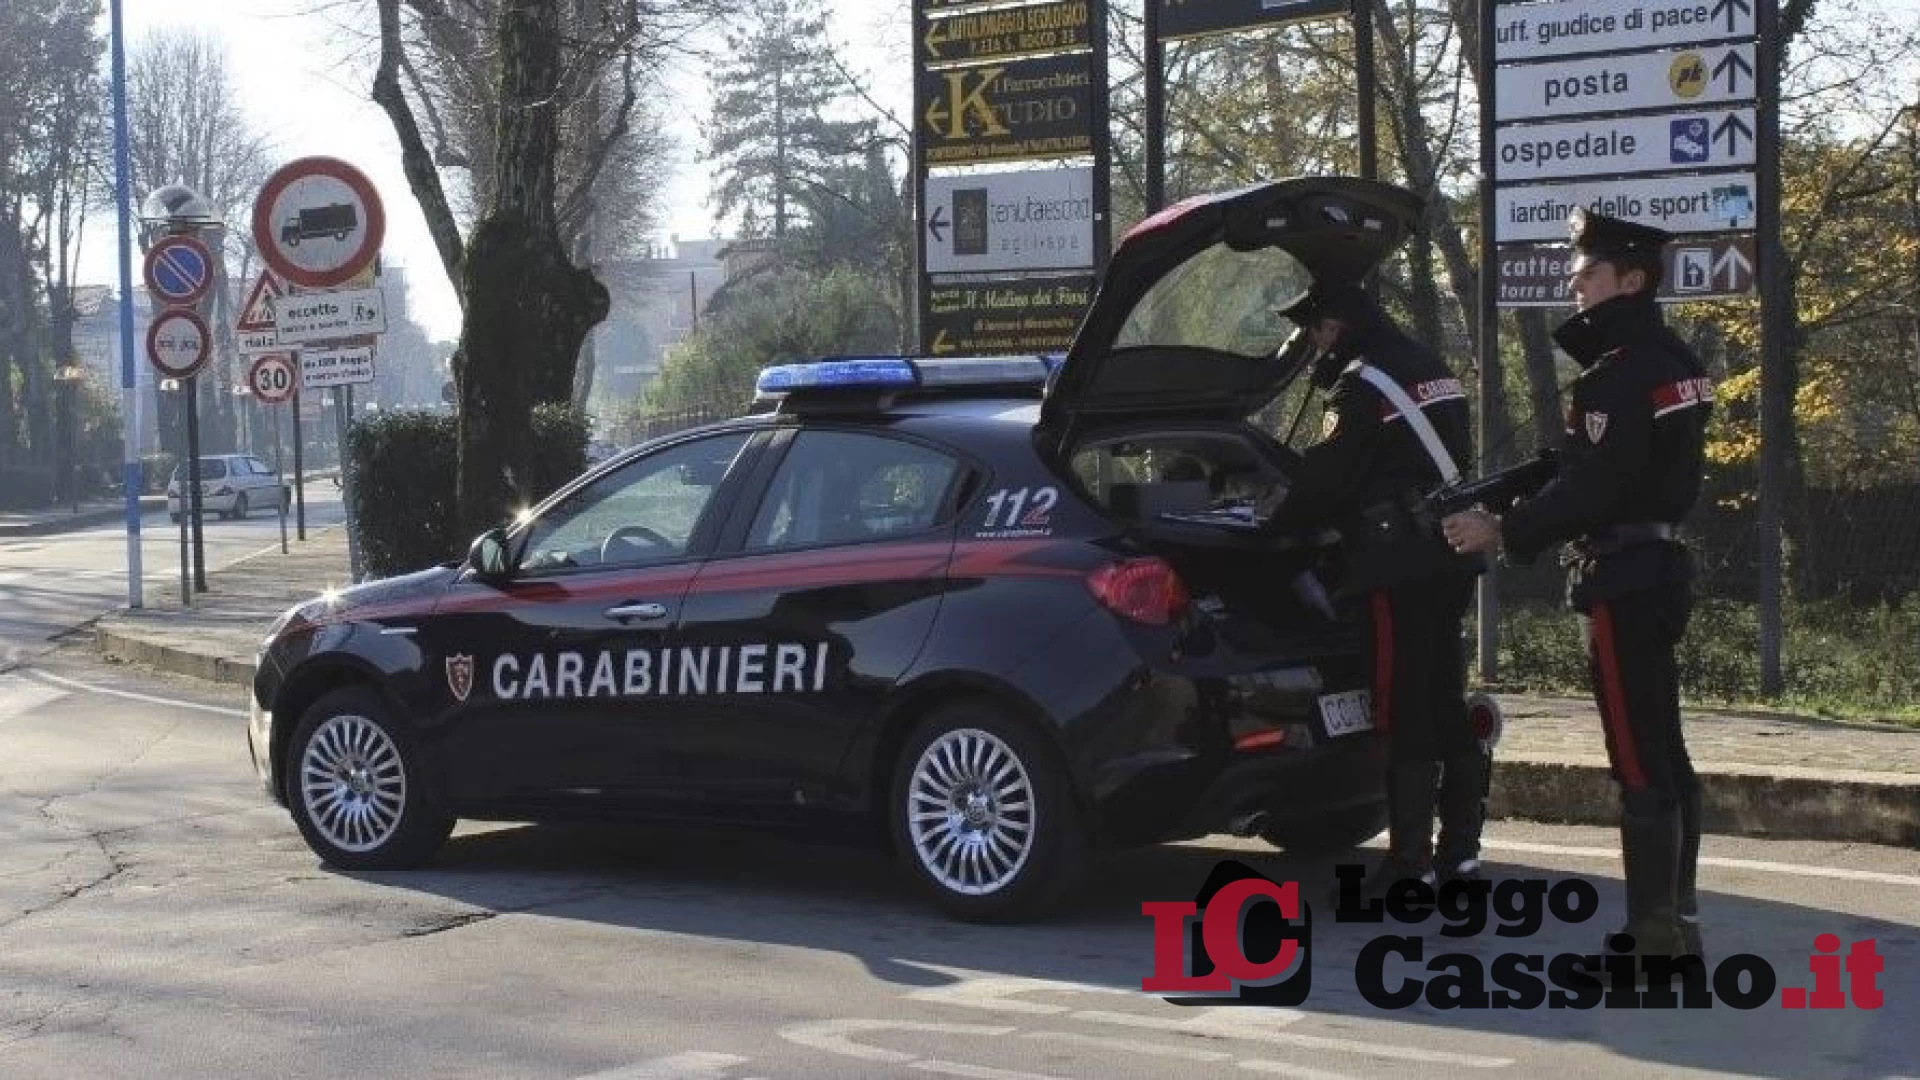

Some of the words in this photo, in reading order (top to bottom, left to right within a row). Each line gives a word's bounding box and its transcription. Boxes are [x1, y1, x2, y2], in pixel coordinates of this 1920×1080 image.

[1497, 21, 1529, 44] uff.
[1538, 14, 1616, 44] giudice
[1624, 9, 1643, 30] di
[1652, 5, 1708, 32] pace
[1545, 70, 1629, 106] posta
[1501, 129, 1636, 169] ospedale
[1590, 195, 1642, 217] dello
[1650, 191, 1709, 220] sport
[1501, 284, 1546, 299] torre
[288, 303, 339, 319] eccetto
[260, 367, 288, 391] 30
[984, 487, 1059, 527] 112
[492, 641, 830, 701] CARABINIERI
